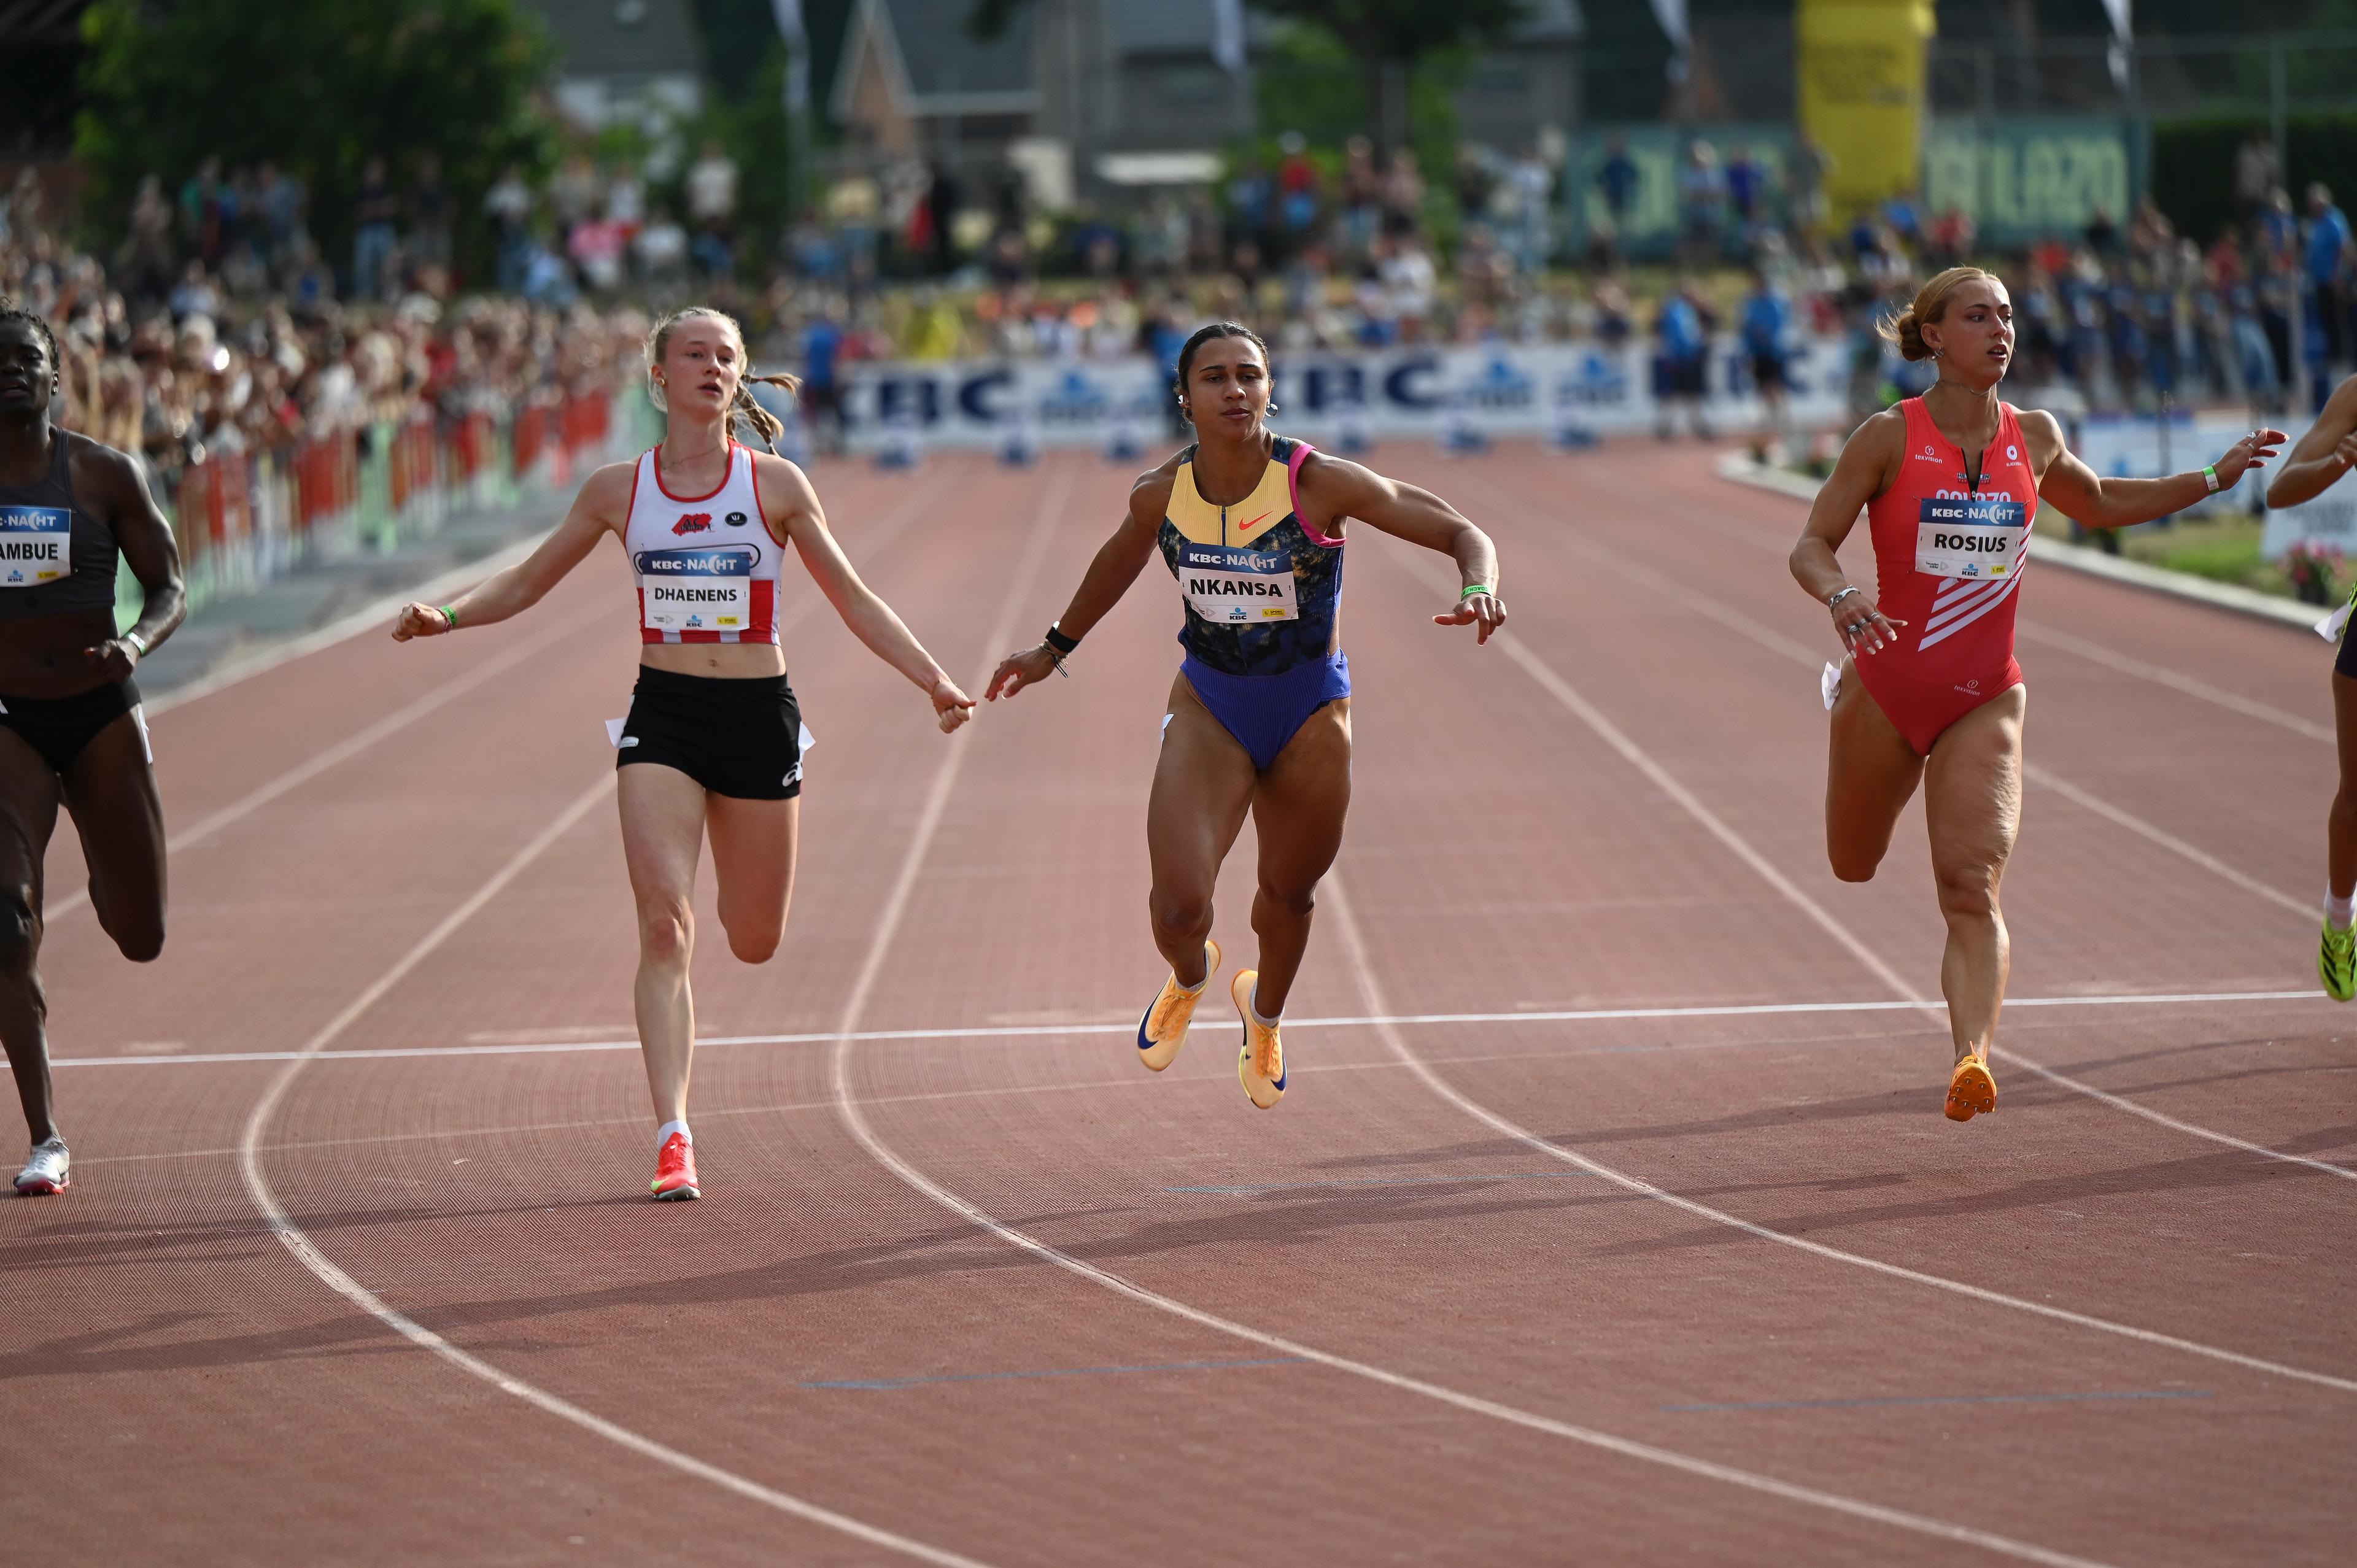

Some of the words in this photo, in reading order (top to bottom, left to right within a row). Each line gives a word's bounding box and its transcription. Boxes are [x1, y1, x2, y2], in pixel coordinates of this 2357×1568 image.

[1915, 454, 1943, 464] texvision
[1934, 533, 2007, 553] ROSIUS
[654, 587, 738, 601] DHAENENS
[1190, 579, 1283, 598] NKANSA
[1954, 685, 1980, 696] texvision
